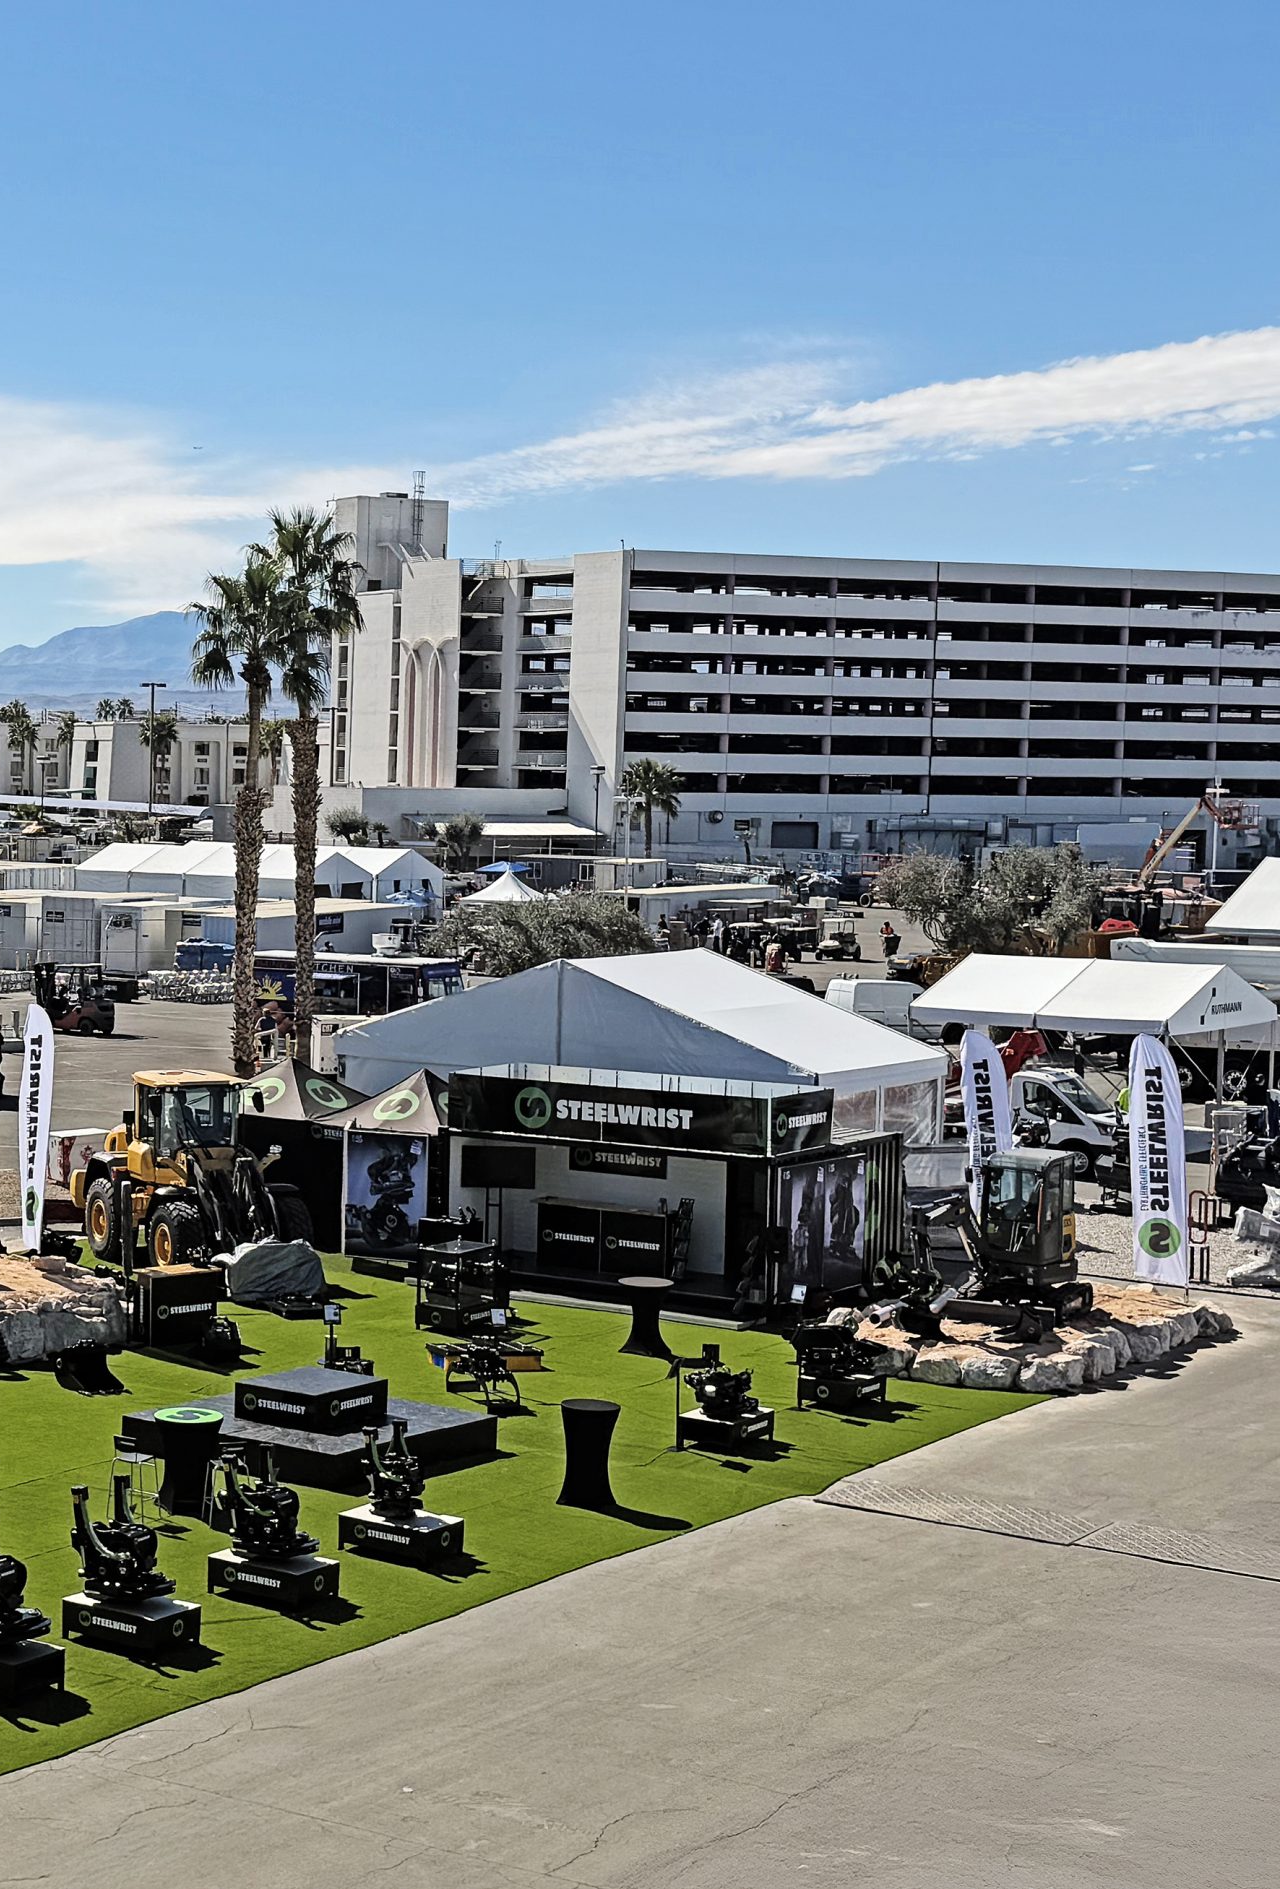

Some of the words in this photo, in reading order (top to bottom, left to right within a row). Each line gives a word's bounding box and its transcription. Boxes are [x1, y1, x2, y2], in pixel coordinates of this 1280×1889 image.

[315, 962, 354, 973] TCHEN
[1211, 1001, 1242, 1015] RUTHMANN
[555, 1099, 693, 1130] STEELWRIST
[788, 1111, 828, 1129] STEELWRIST
[594, 1151, 662, 1168] STEELWRIST
[618, 1239, 661, 1251] STEELWRIST
[170, 1302, 213, 1315] STEELWRIST
[257, 1398, 307, 1415] STEELWRIST
[340, 1395, 373, 1411] STEELWRIST
[367, 1529, 410, 1545] STEELWRIST
[237, 1571, 281, 1588] STEELWRIST
[92, 1616, 137, 1634] STEELWRIST
